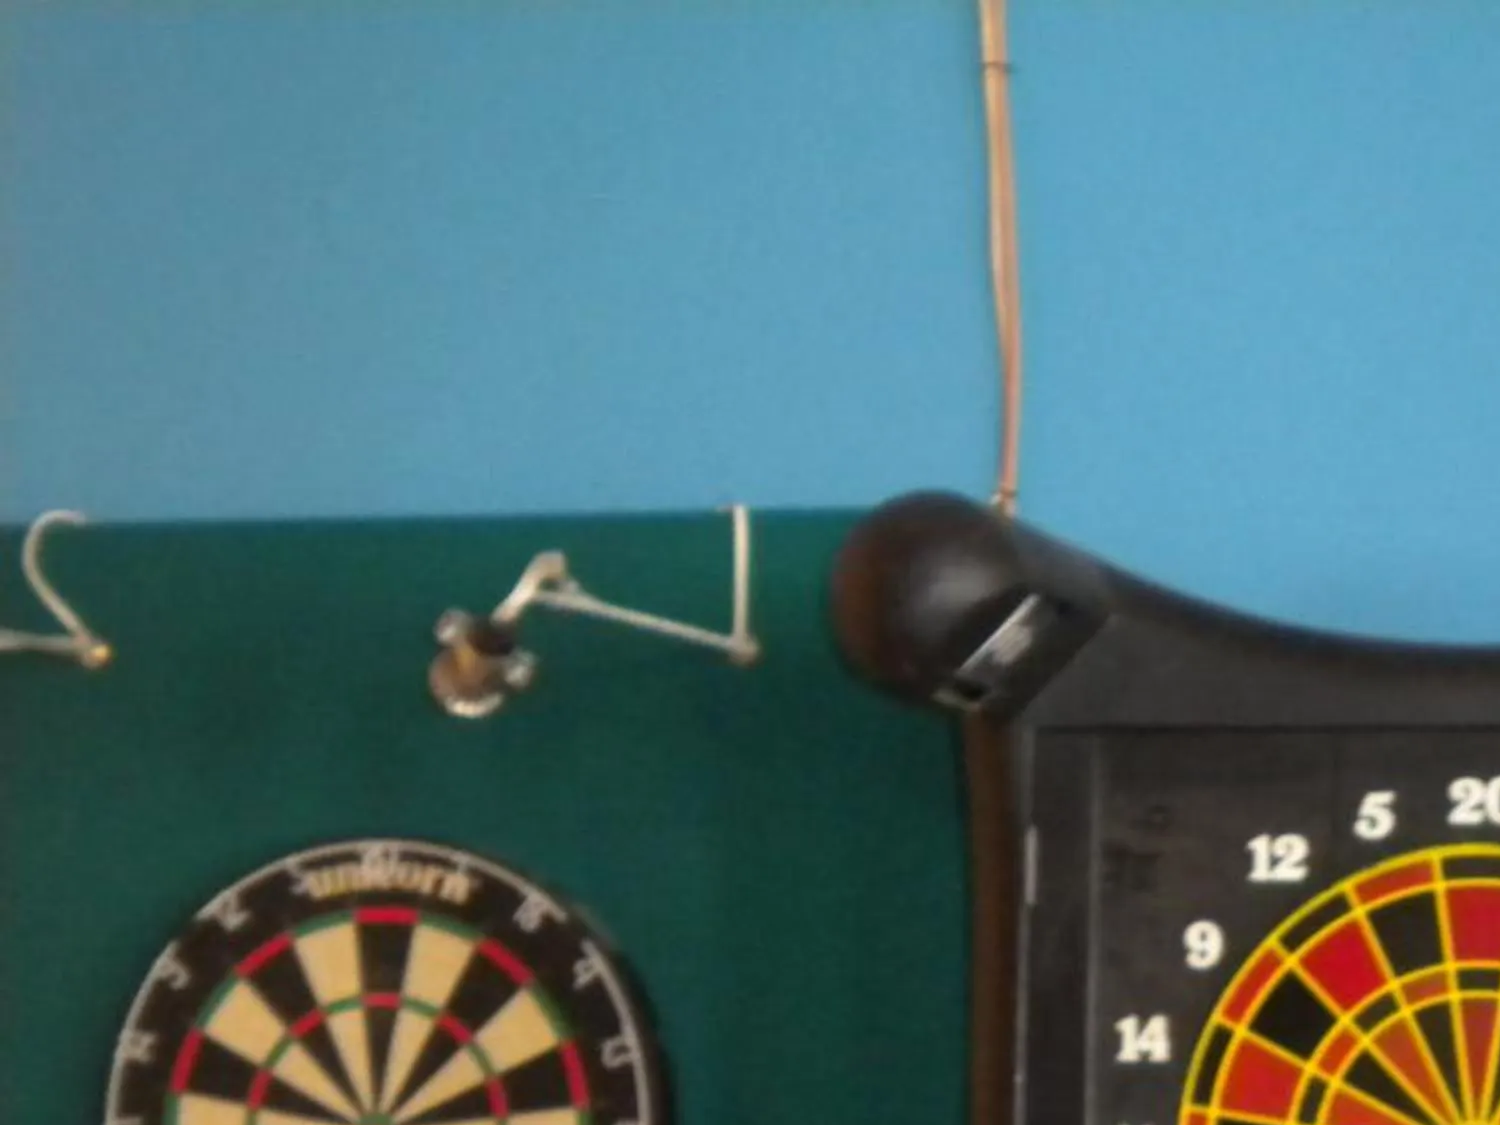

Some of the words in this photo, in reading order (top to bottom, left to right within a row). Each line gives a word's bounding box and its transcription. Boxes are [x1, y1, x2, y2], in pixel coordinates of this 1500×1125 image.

[1352, 789, 1397, 842] 5
[1246, 832, 1311, 884] 12
[1182, 918, 1226, 972] 9
[1114, 1013, 1173, 1065] 14
